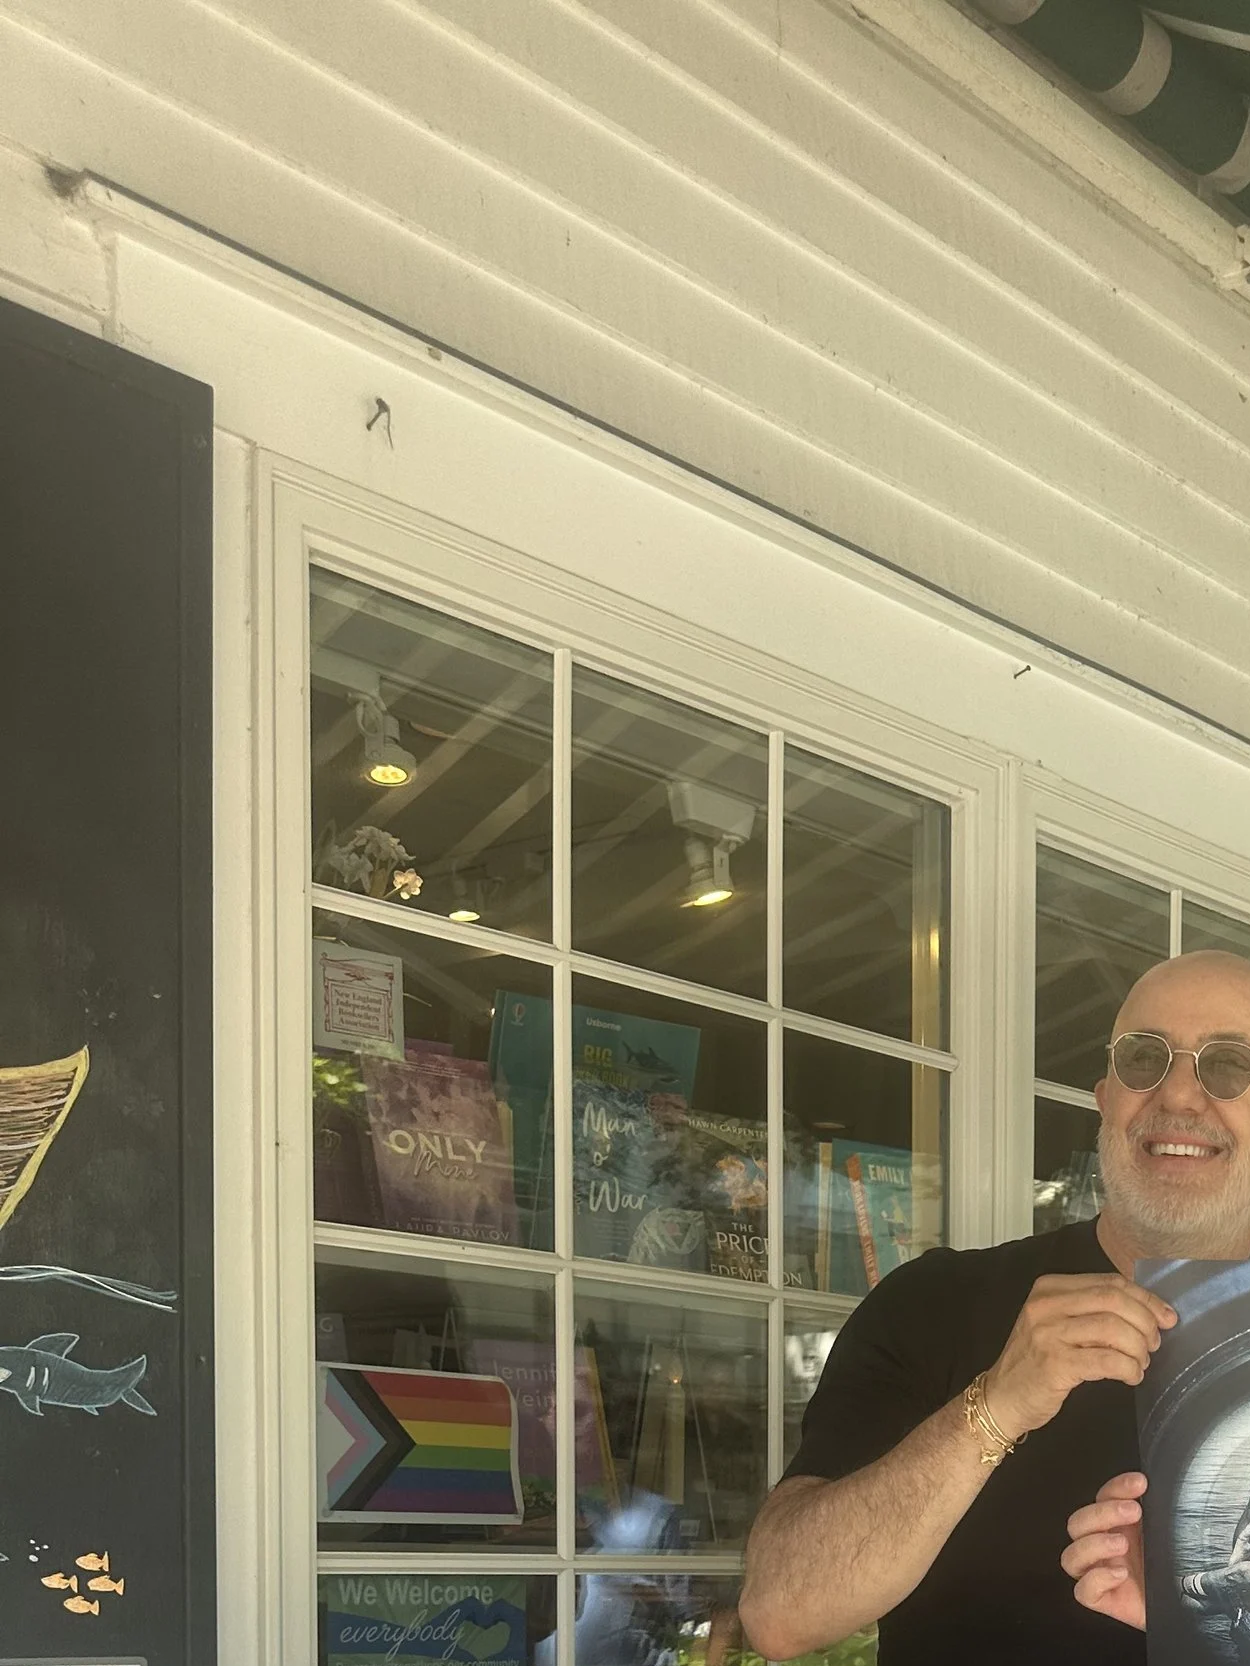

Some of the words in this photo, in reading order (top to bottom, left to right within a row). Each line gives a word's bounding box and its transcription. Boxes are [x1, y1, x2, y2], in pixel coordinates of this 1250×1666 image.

[584, 1045, 612, 1067] BIG
[583, 1101, 637, 1139] Man
[687, 1118, 718, 1131] HAWN
[719, 1124, 768, 1139] CARPENTE
[383, 1129, 488, 1163] ONLY
[867, 1164, 905, 1185] EMILY
[589, 1176, 648, 1213] War
[731, 1222, 754, 1233] THE
[338, 1578, 378, 1605] We
[384, 1578, 494, 1605] Welcome
[340, 1609, 465, 1662] everybody
